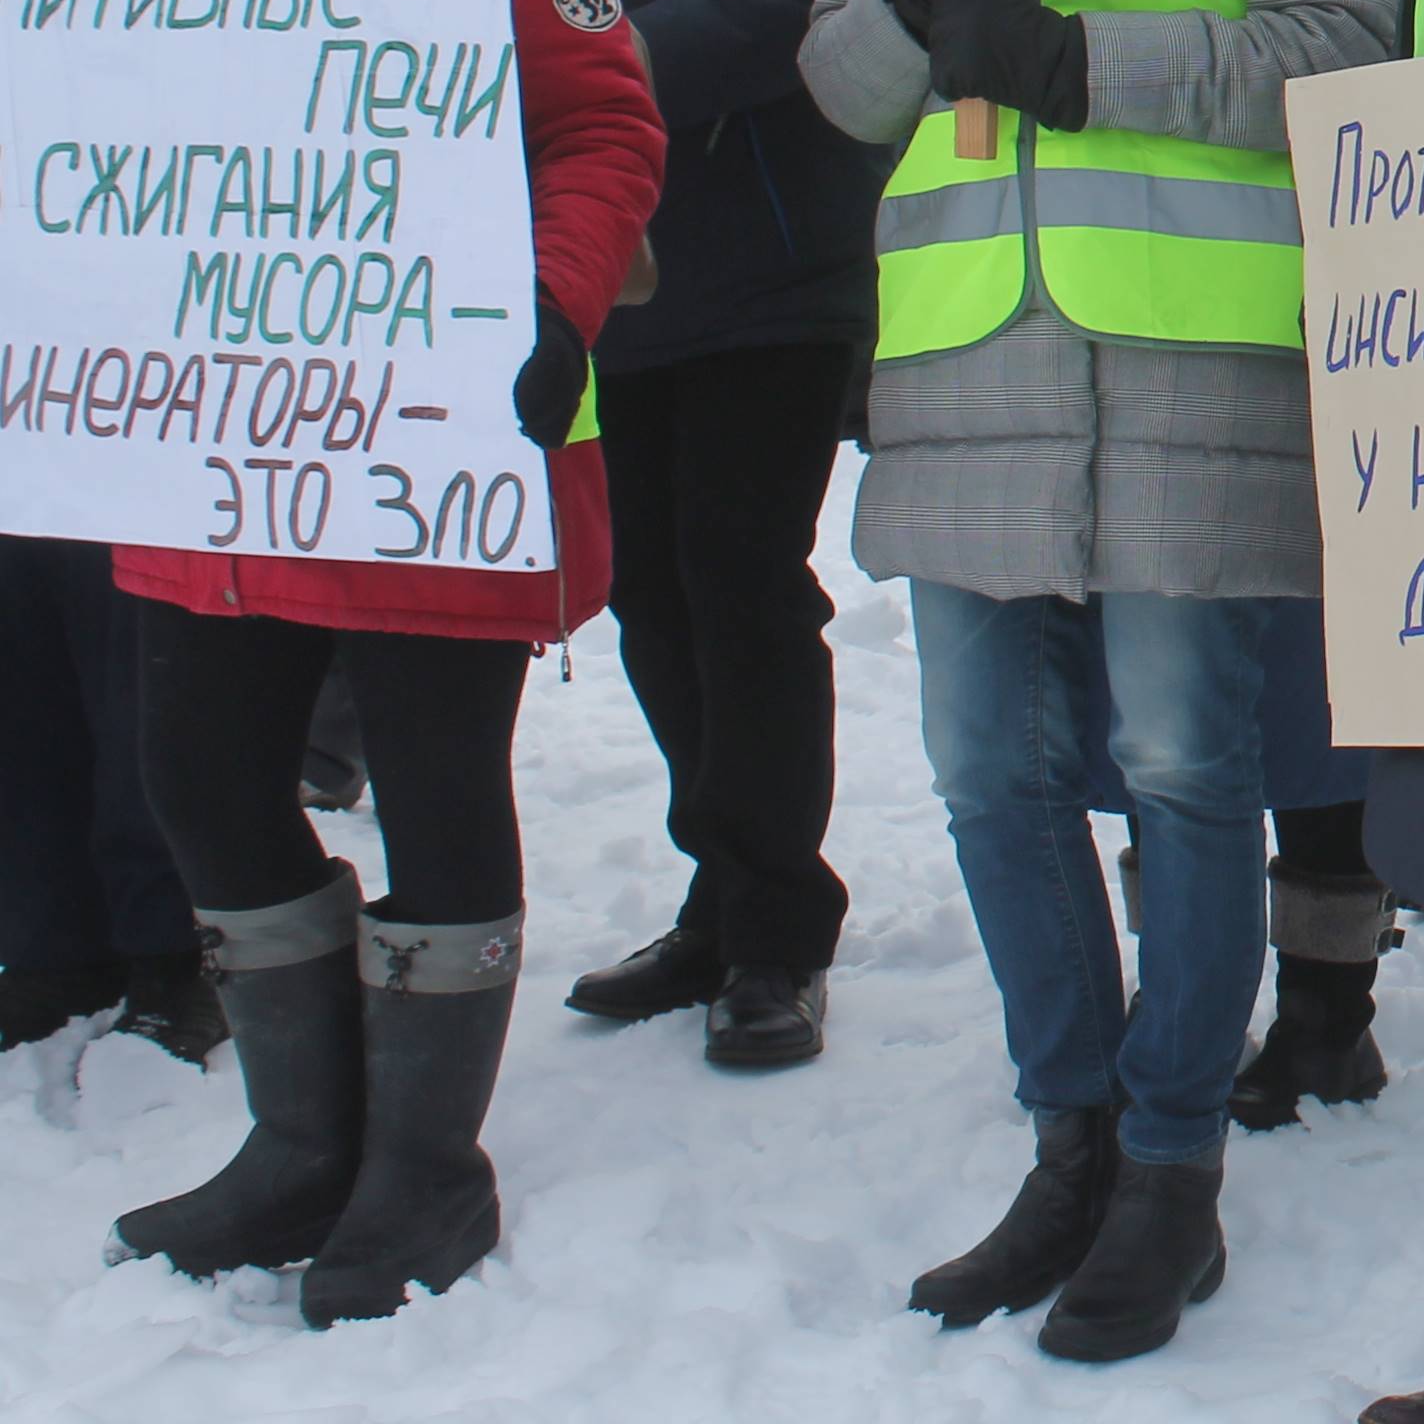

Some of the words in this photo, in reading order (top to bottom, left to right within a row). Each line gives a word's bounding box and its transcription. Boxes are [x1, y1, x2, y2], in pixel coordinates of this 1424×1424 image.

[35, 141, 401, 243] СЖИГАНИЯ
[206, 456, 332, 551] ЭТО
[367, 464, 537, 568] ЗЛО.
